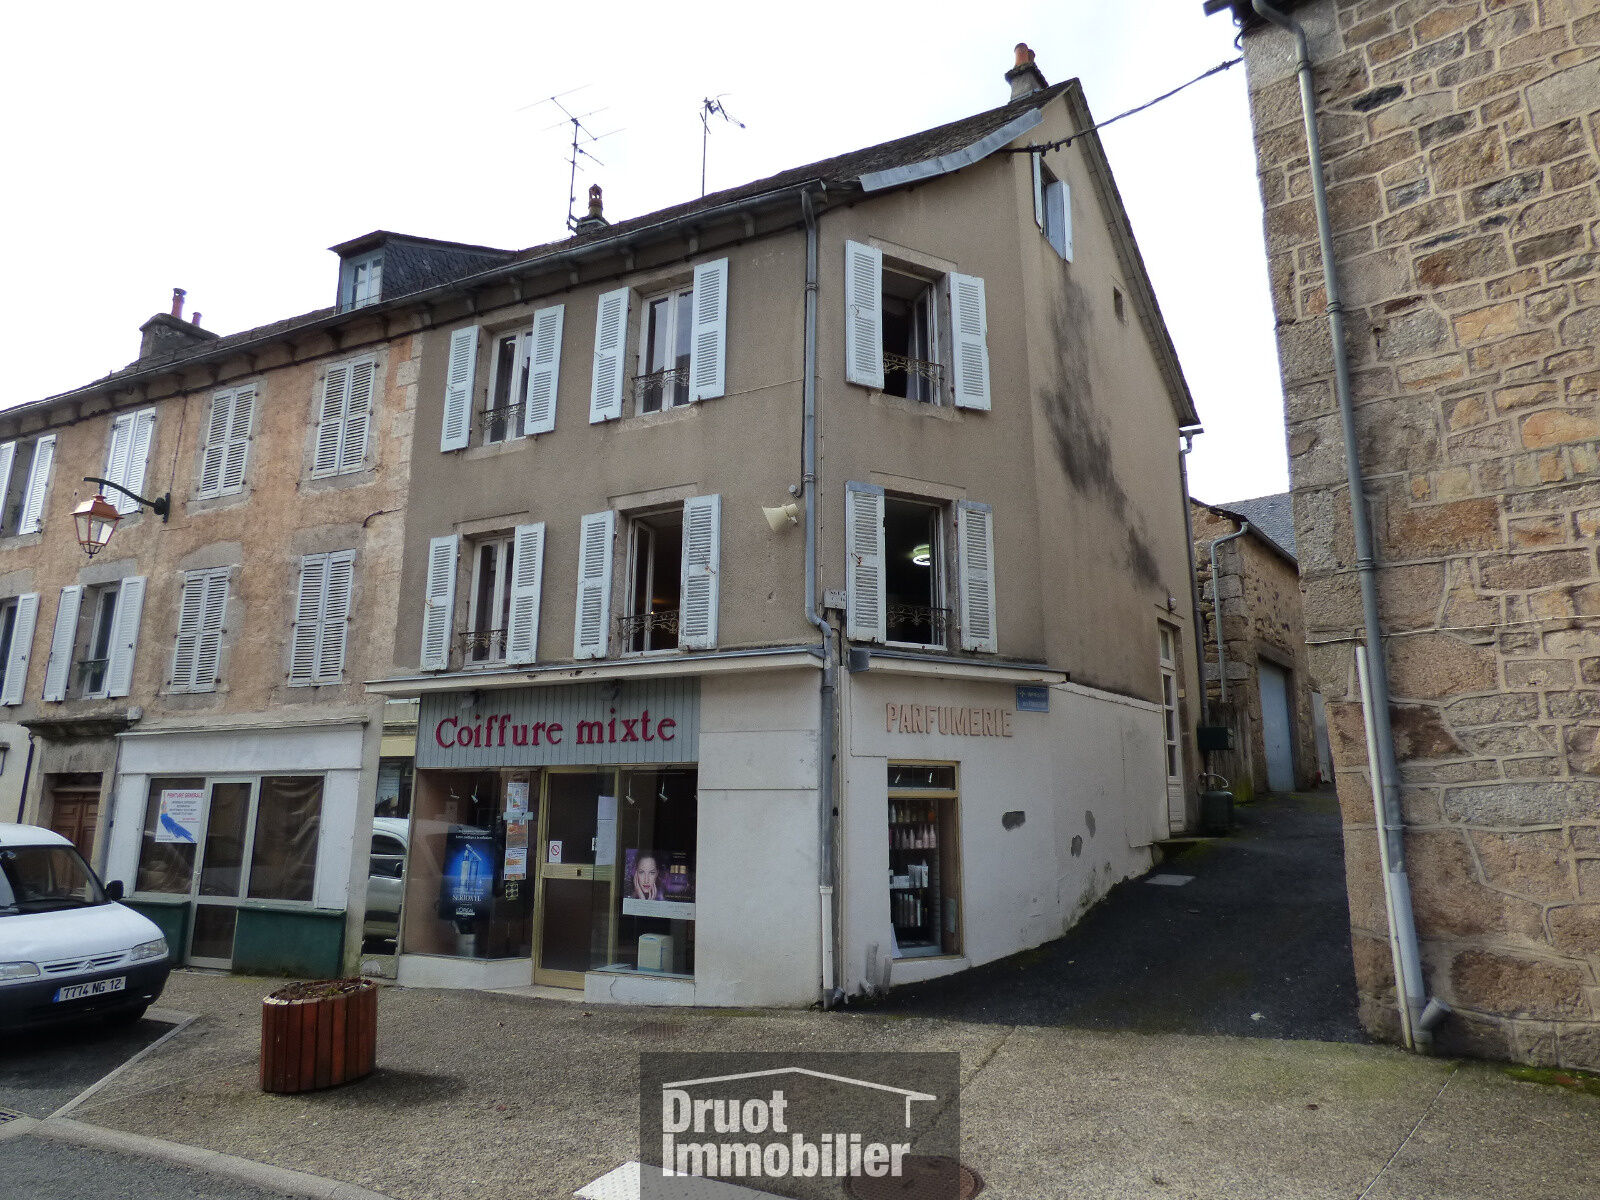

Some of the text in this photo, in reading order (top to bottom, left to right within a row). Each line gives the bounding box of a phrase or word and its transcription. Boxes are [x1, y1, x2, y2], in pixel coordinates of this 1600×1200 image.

[435, 707, 677, 749] Coiffure mixte
[886, 703, 1013, 737] PARFUMERIE
[64, 978, 121, 998] 7774 NG 12
